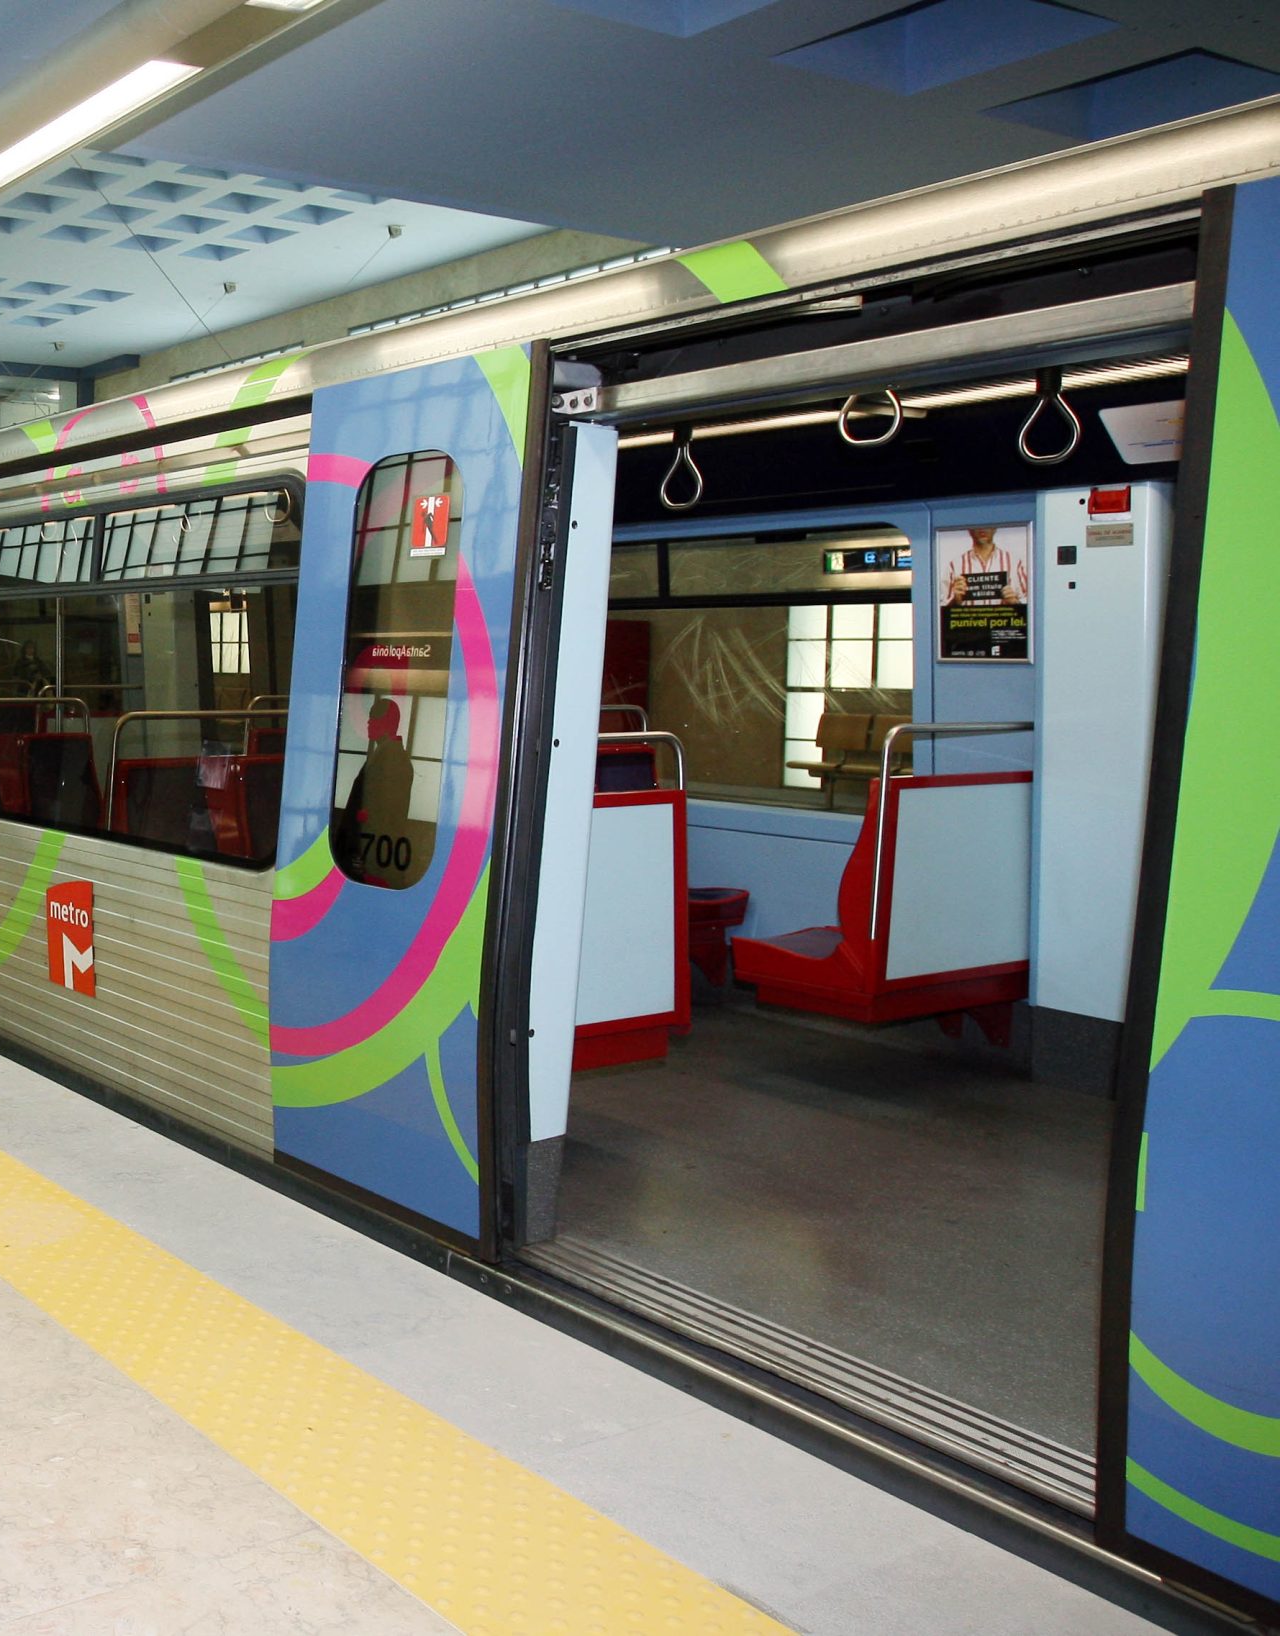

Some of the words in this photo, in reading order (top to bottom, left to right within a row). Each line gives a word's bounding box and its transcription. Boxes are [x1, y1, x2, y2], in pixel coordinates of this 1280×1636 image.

[967, 575, 1000, 583] CLIENTE
[950, 617, 987, 630] punível
[990, 619, 1008, 629] por
[1010, 616, 1027, 627] lei.
[50, 901, 89, 928] metro
